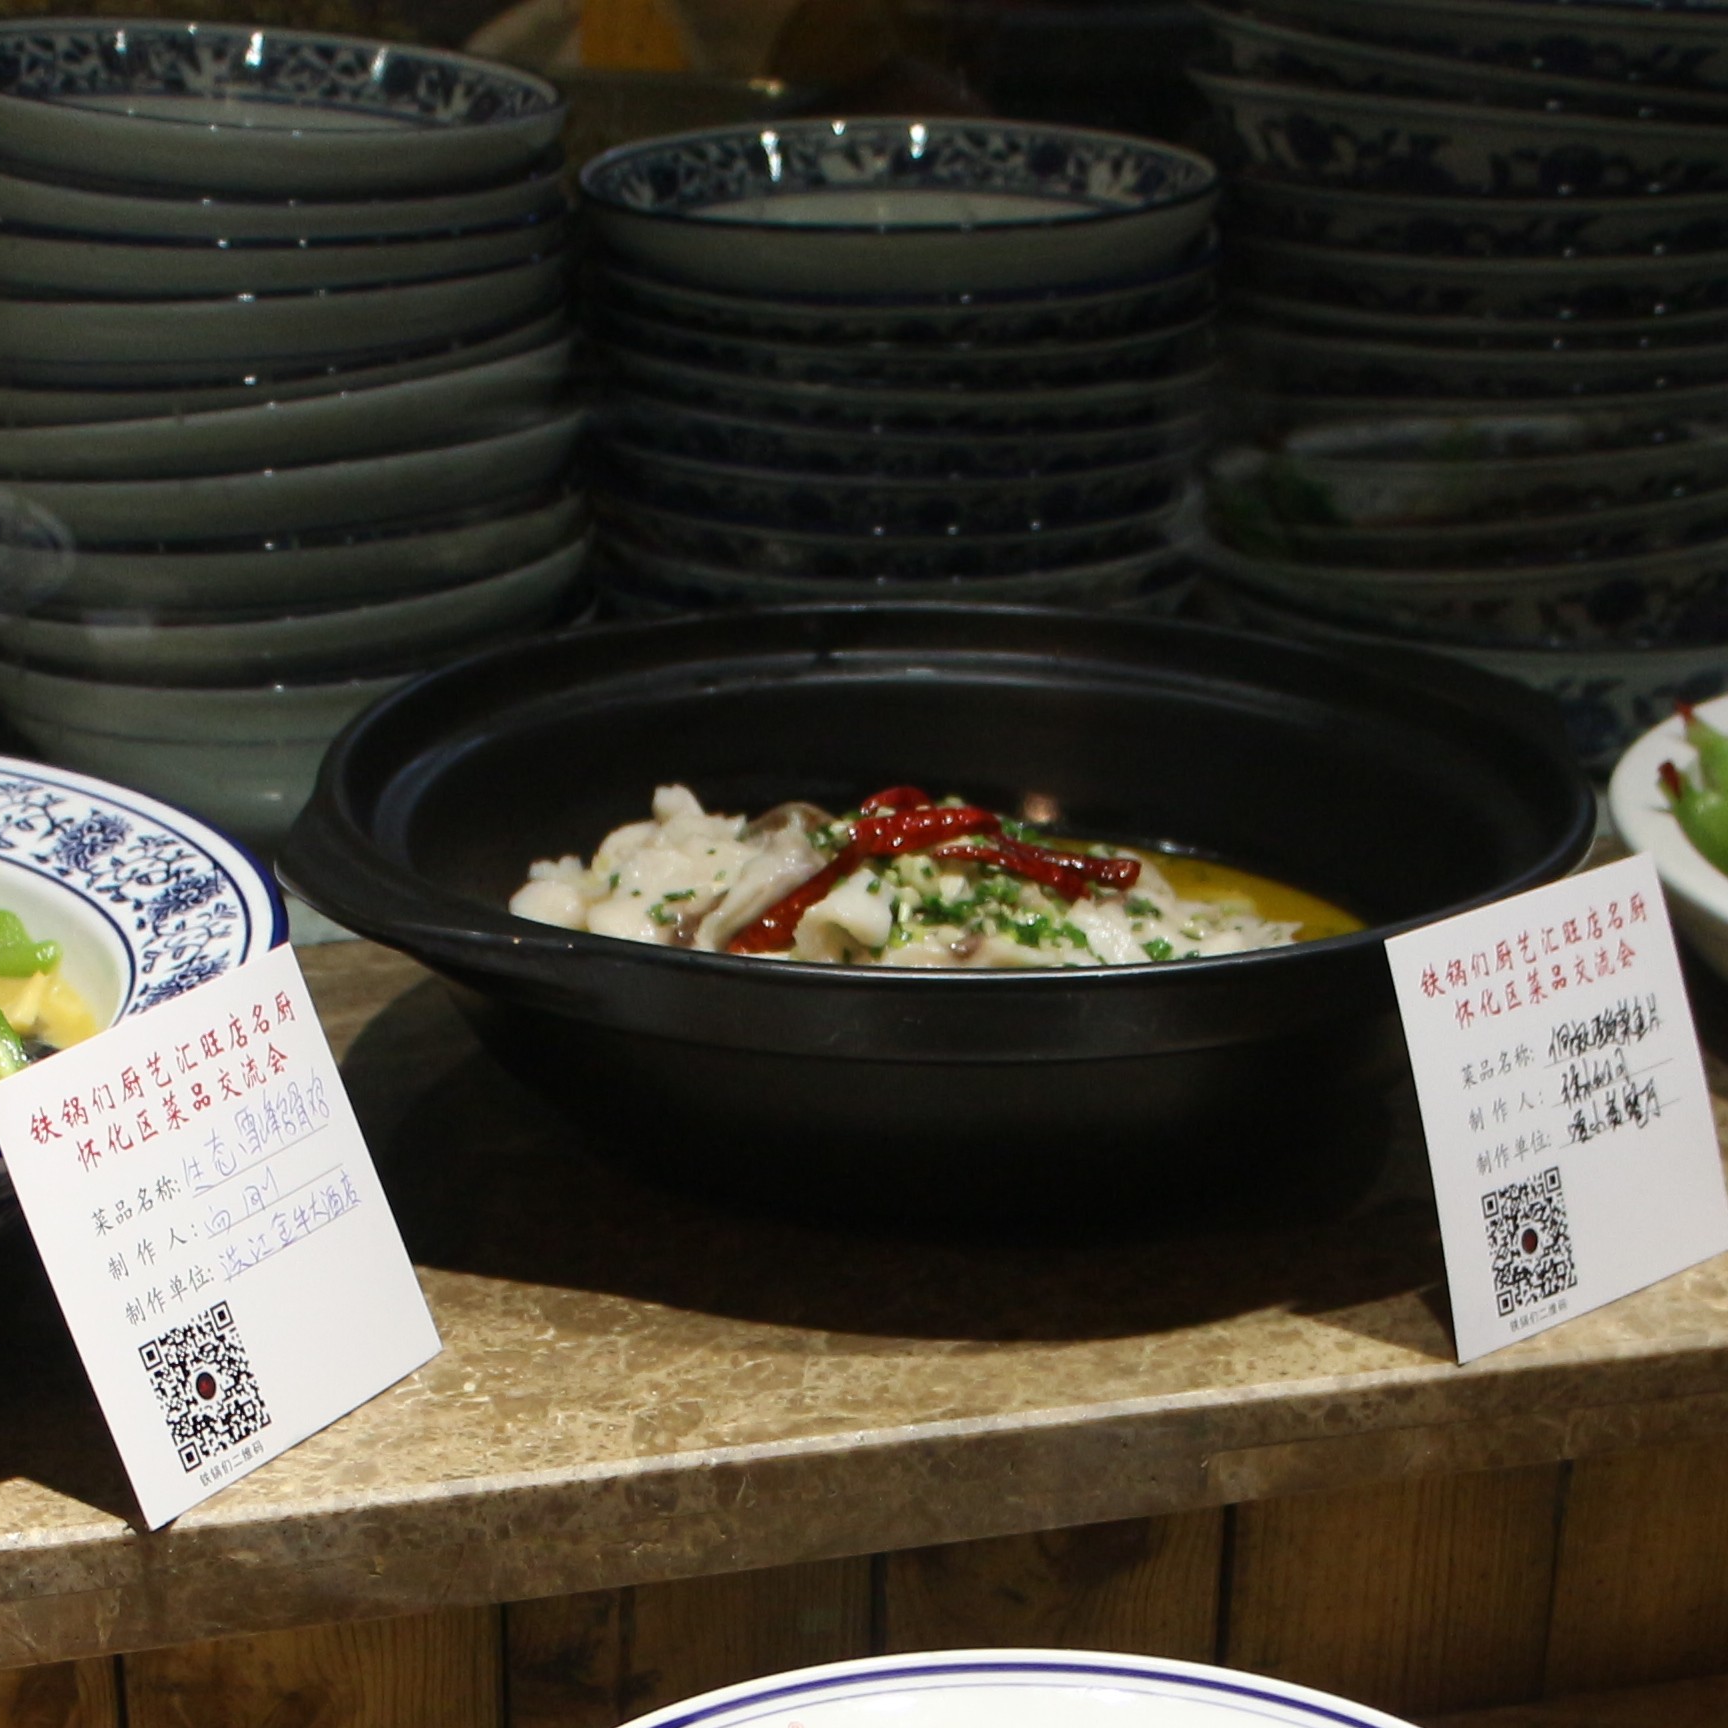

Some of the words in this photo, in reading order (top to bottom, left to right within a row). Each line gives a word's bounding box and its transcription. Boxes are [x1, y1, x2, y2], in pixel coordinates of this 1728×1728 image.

[1420, 892, 1646, 998] 铁锅们厨艺汇旺店名厨
[1454, 938, 1636, 1029] 怀化区菜品交流会
[30, 990, 295, 1144] 铁锅们厨艺汇旺店名厨
[76, 1042, 288, 1172] 怀化区菜品交流会
[199, 1440, 265, 1487] 铁锅们二维码
